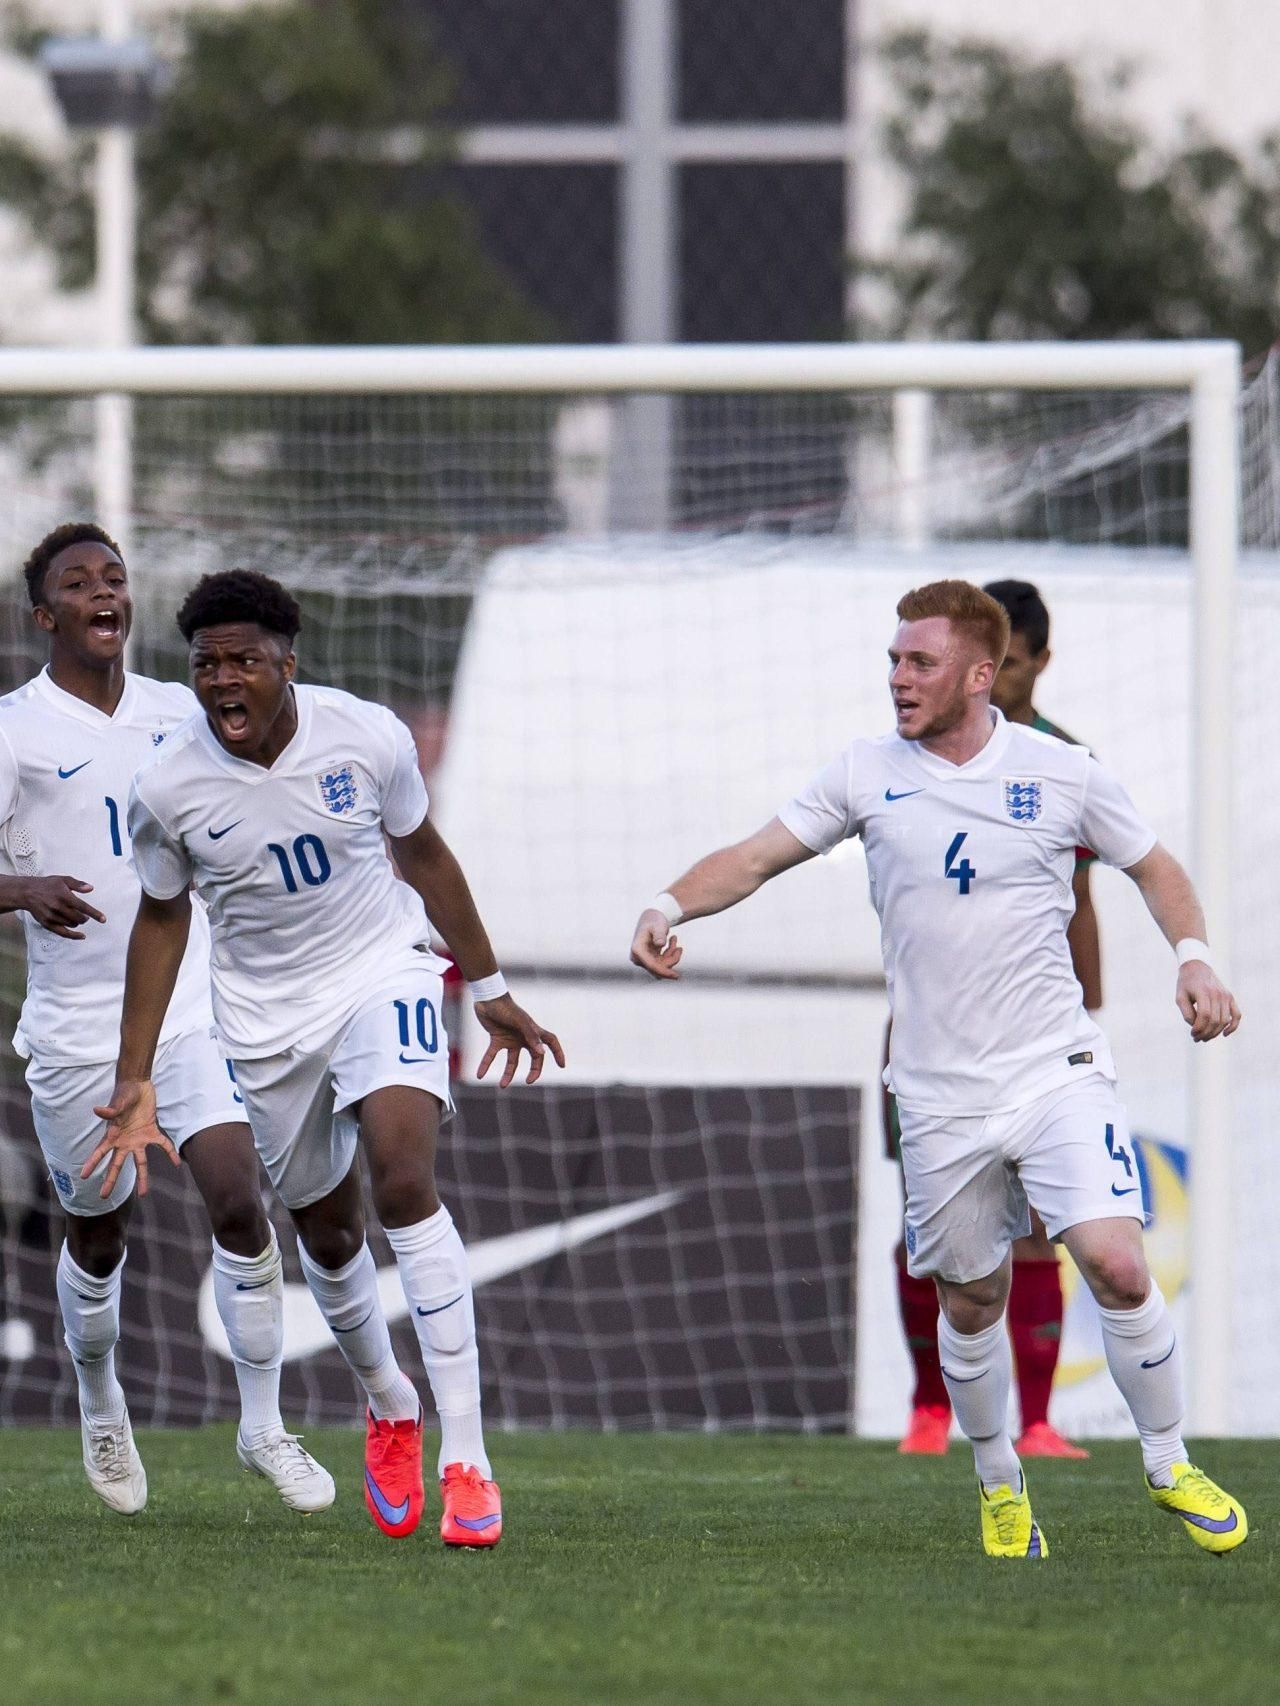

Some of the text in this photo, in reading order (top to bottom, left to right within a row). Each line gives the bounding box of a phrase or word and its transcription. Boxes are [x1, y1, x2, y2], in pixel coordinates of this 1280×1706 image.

[104, 796, 131, 856] 1
[267, 833, 331, 893] 10
[945, 832, 976, 895] 4
[393, 998, 438, 1053] 10
[1105, 1123, 1133, 1178] 4
